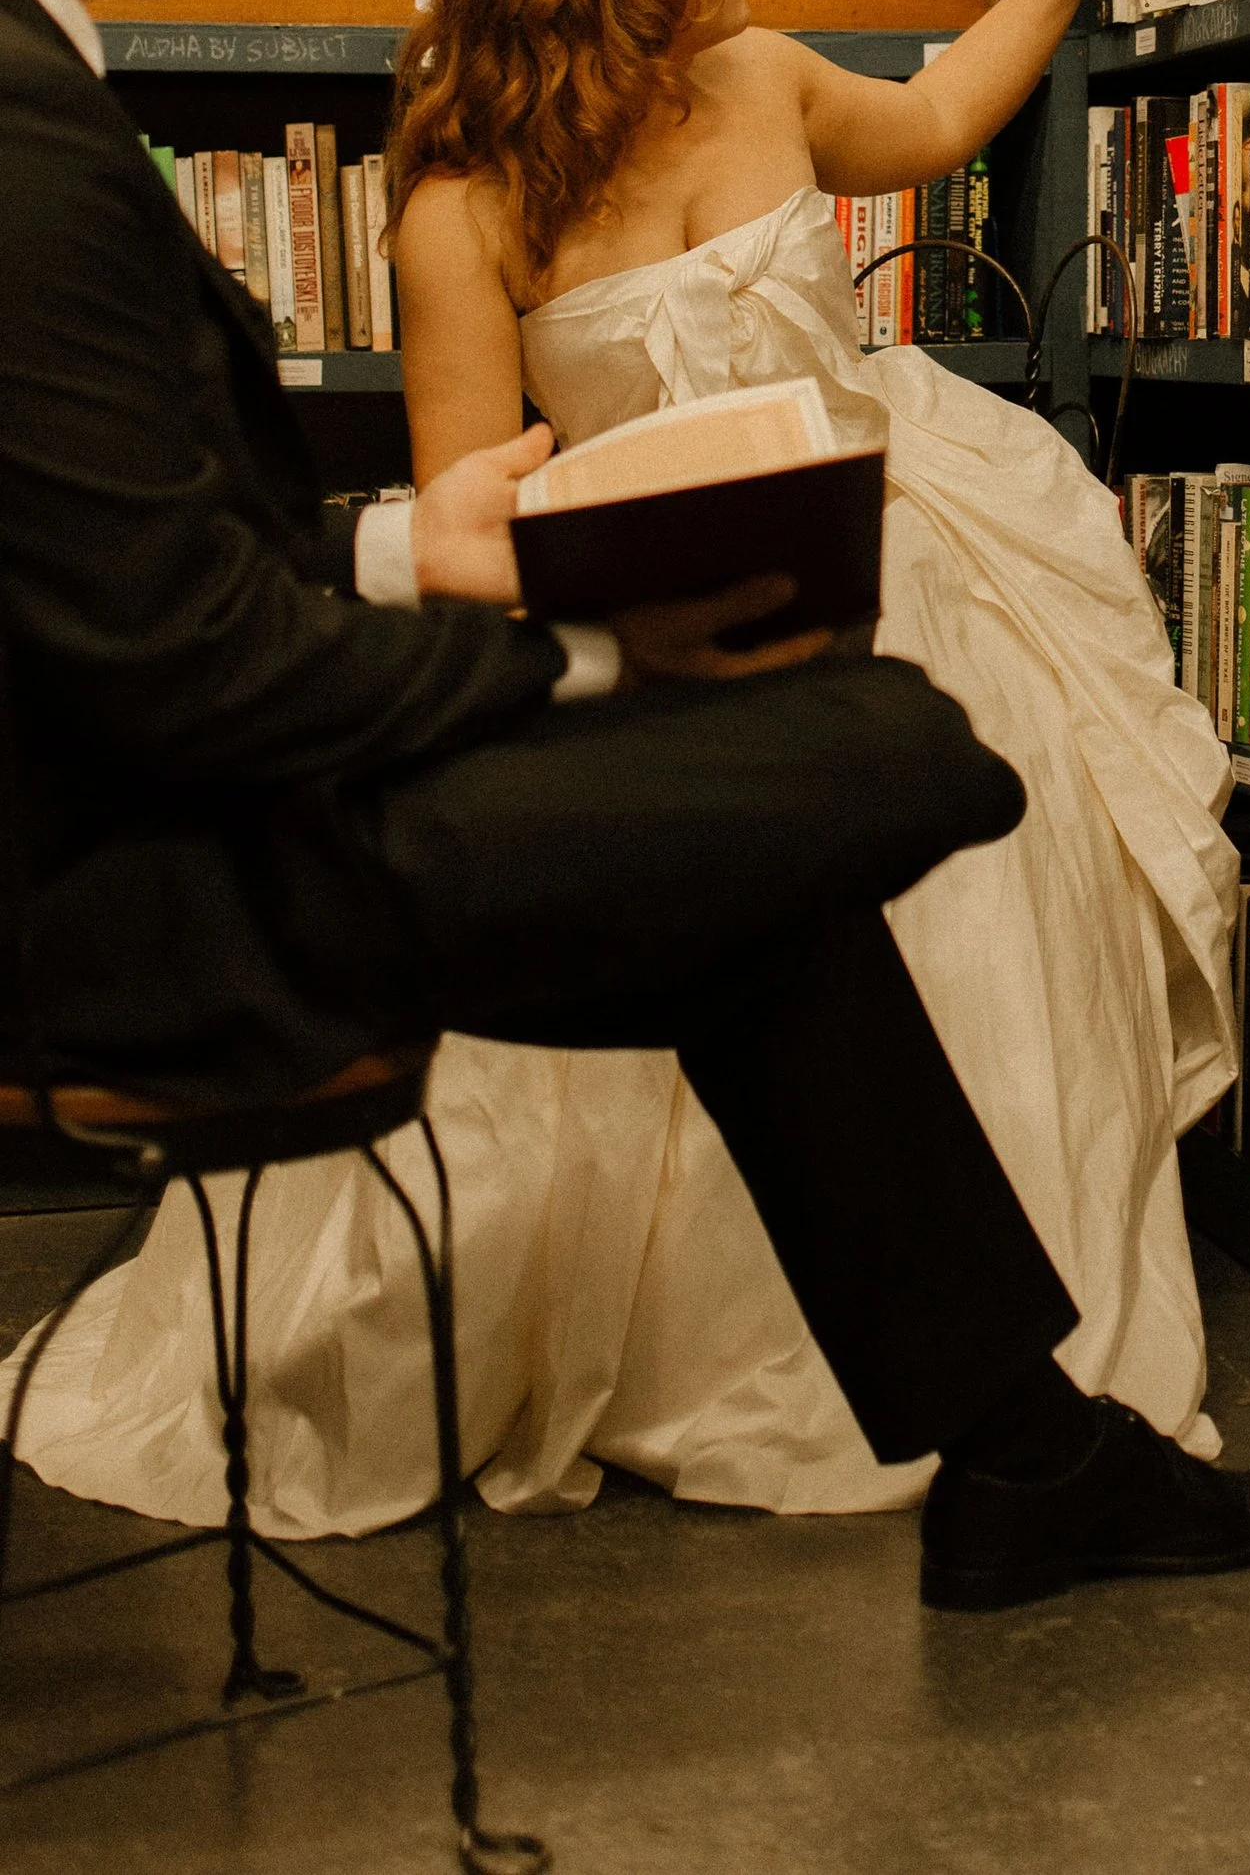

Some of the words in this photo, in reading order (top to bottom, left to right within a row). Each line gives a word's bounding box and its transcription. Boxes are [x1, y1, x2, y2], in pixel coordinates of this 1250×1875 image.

[125, 33, 200, 62] ALPHA
[208, 36, 237, 62] BY
[247, 33, 346, 63] SUBJECT
[202, 174, 212, 217] AMERICAN
[250, 184, 260, 213] THIS
[289, 187, 314, 228] FYODOR
[982, 175, 990, 220] ANOTHER
[1197, 161, 1207, 223] Letters
[856, 206, 868, 253] BIG
[885, 196, 893, 236] PURPOSE
[251, 217, 263, 258] HOUSE
[1153, 219, 1163, 257] TERRY
[291, 230, 320, 303] DOSTOYEVSKY
[1153, 260, 1163, 314] LENZNER
[877, 273, 893, 318] FERGUSON
[1184, 483, 1196, 544] STRAIGHT
[1239, 497, 1248, 526] LATE
[1184, 571, 1195, 598] TILL
[1238, 576, 1247, 601] BALL
